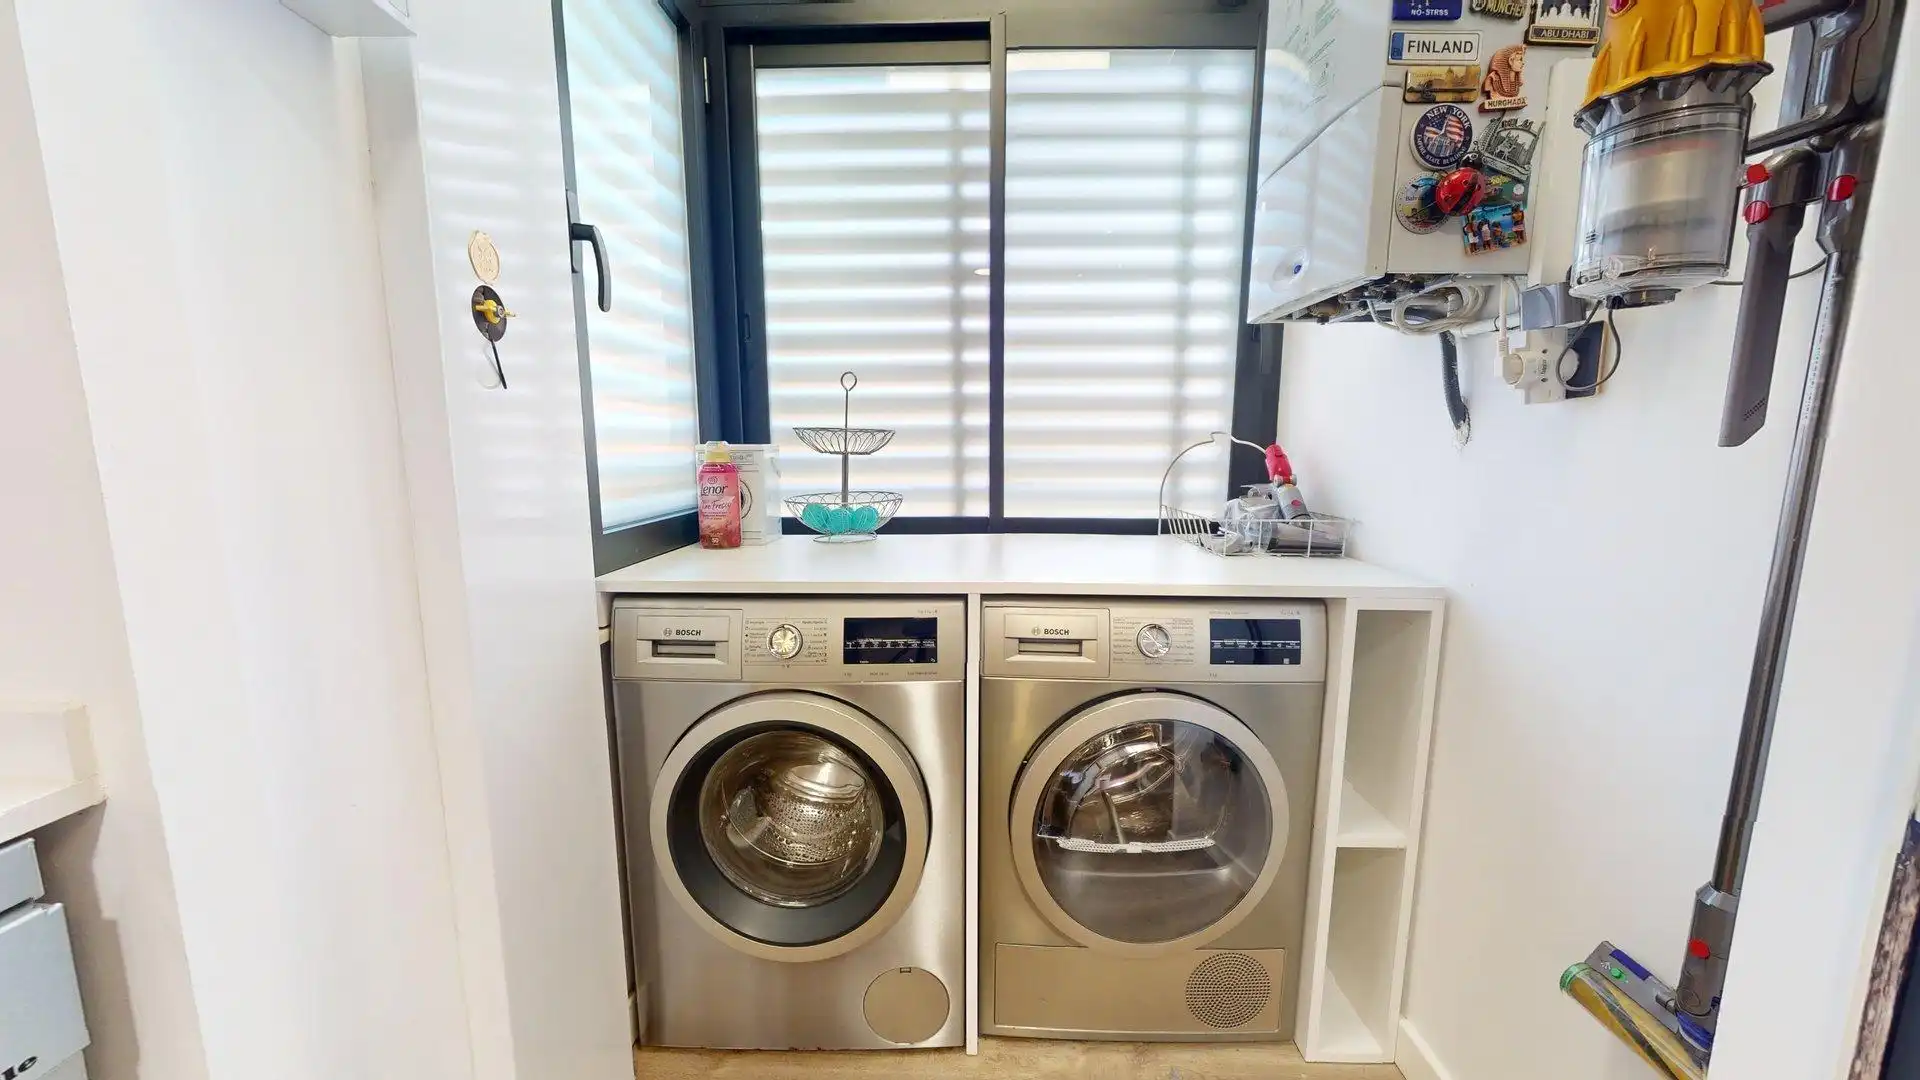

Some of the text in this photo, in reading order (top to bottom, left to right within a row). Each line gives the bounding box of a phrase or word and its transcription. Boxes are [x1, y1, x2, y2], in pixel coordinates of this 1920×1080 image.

[1540, 30, 1590, 39] ABU DHABI
[1407, 41, 1474, 54] FINLAND
[1426, 106, 1471, 129] NEW YORK
[1043, 628, 1070, 636] BOSCH
